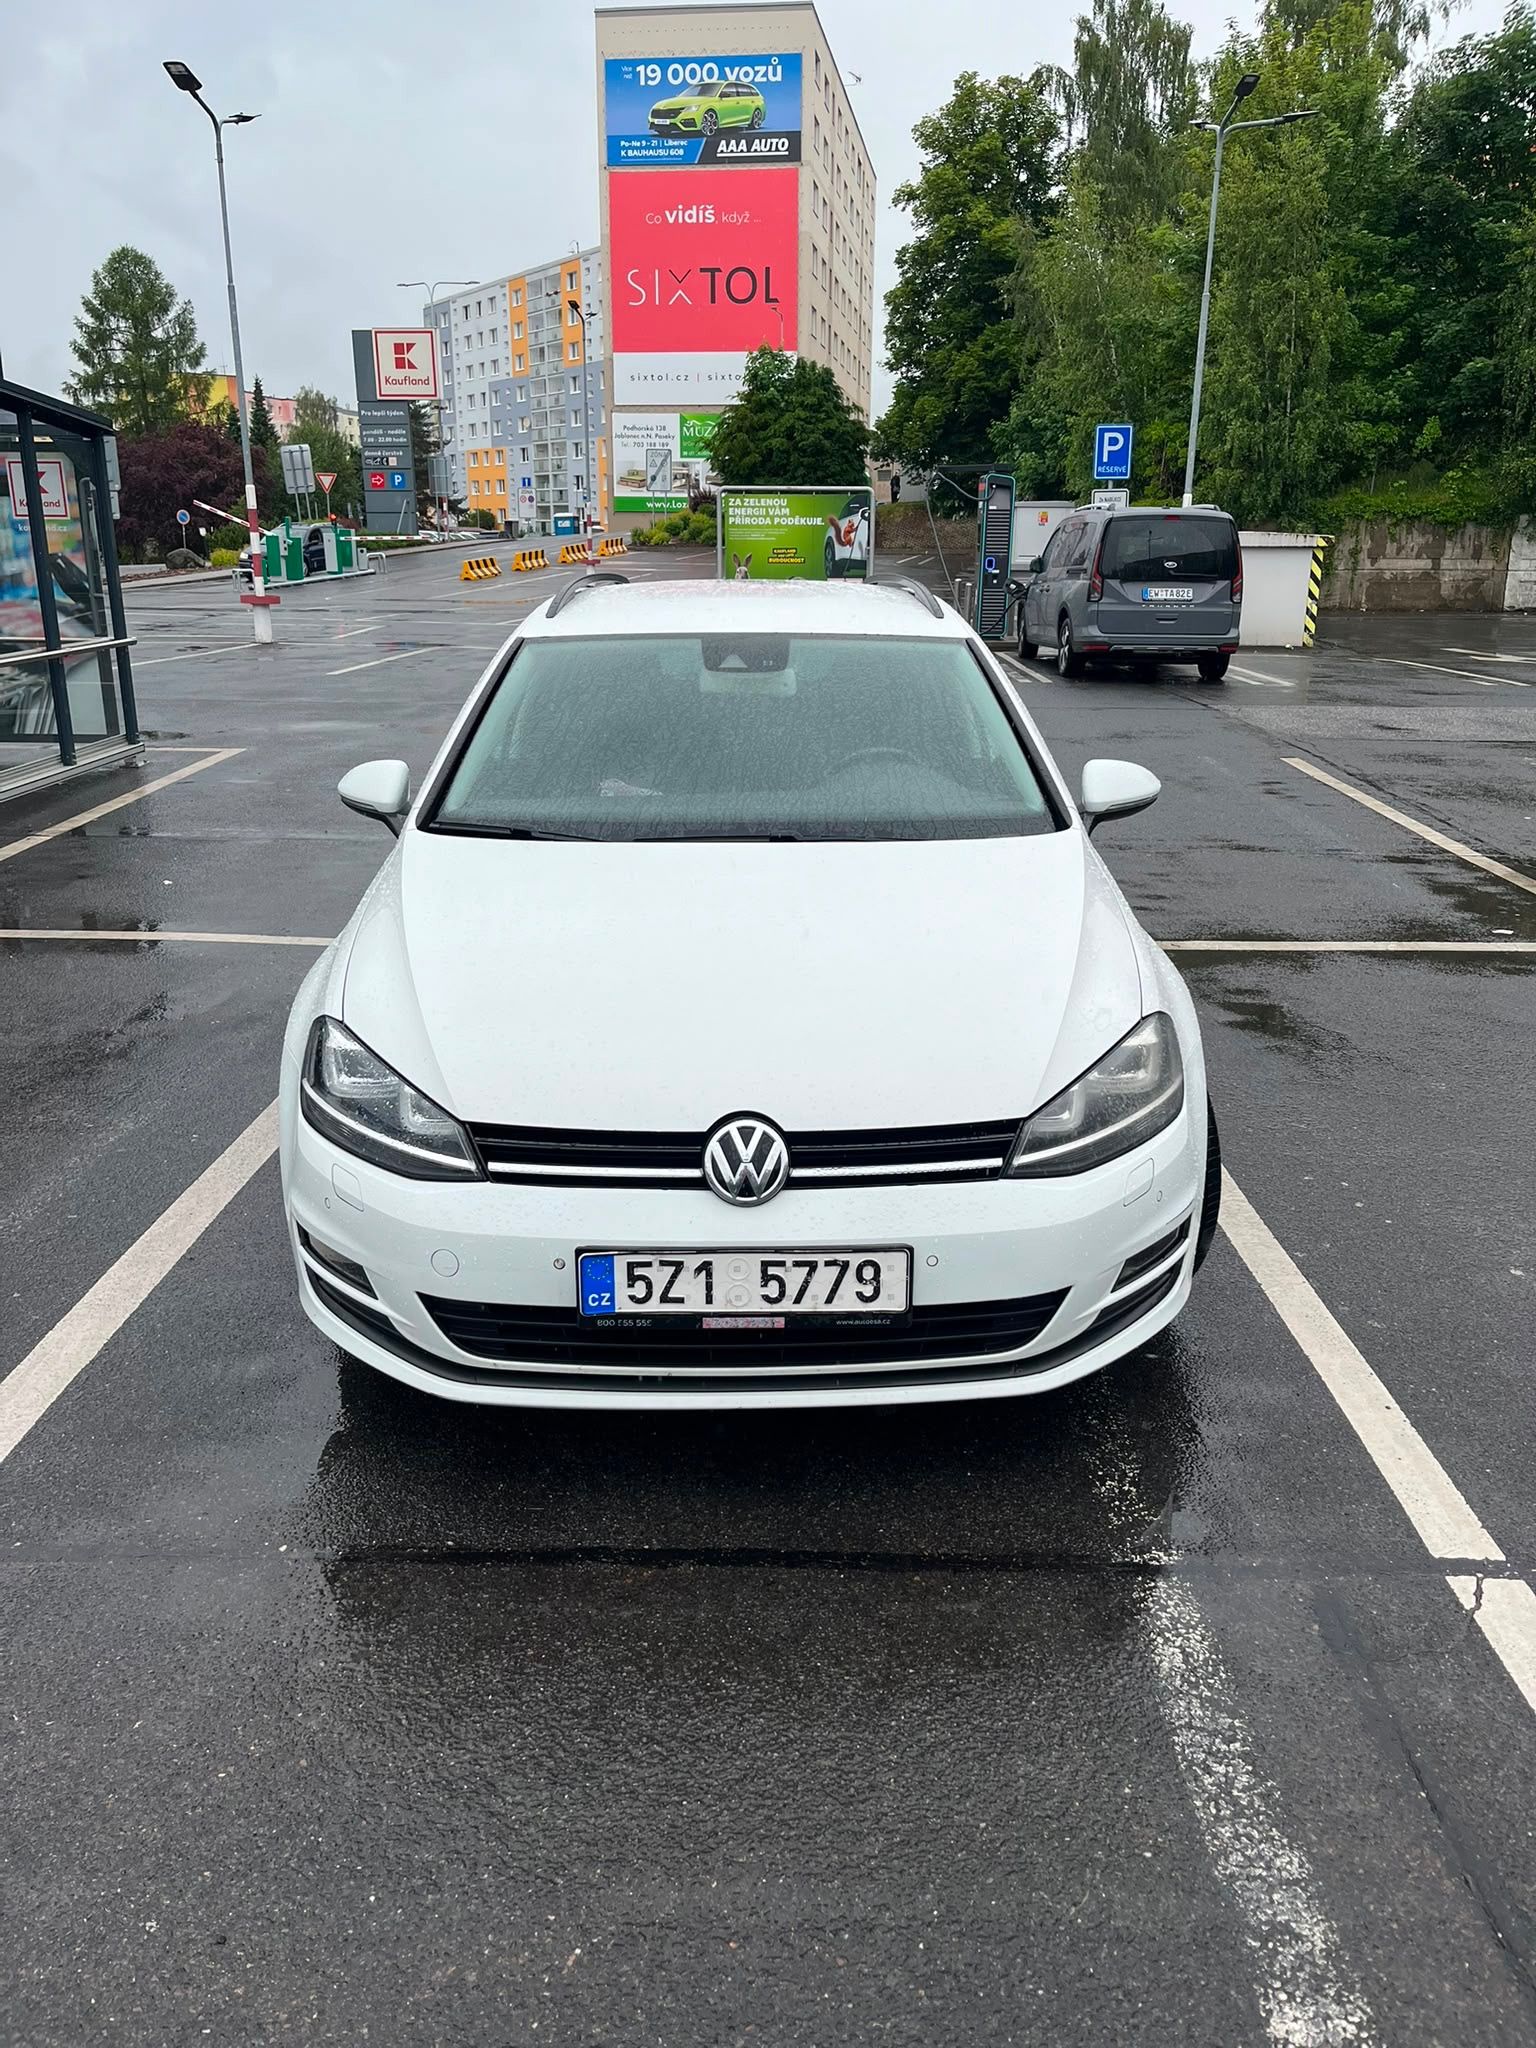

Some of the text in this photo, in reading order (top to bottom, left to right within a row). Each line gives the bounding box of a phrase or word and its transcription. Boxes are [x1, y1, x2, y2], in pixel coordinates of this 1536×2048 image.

[636, 56, 782, 86] 19 000 vozů
[717, 138, 789, 152] AAA AUTO
[627, 149, 669, 157] BAUHAUSU
[646, 213, 662, 225] Co
[721, 211, 751, 226] když
[627, 266, 780, 306] SIXTOL
[384, 375, 430, 387] Kaufland
[630, 372, 690, 382] sixtol.cz
[707, 371, 744, 382] sixto
[1102, 432, 1124, 462] P
[394, 474, 402, 486] P
[19, 499, 60, 508] Kand
[728, 498, 787, 506] ZA ZELENOU
[728, 505, 790, 516] ENERGII VÁM
[728, 515, 825, 526] PŘÍRODA PODĚKUJE.
[1148, 589, 1159, 598] EW
[625, 1259, 882, 1306] 5Z1 5779
[588, 1292, 611, 1307] CZ
